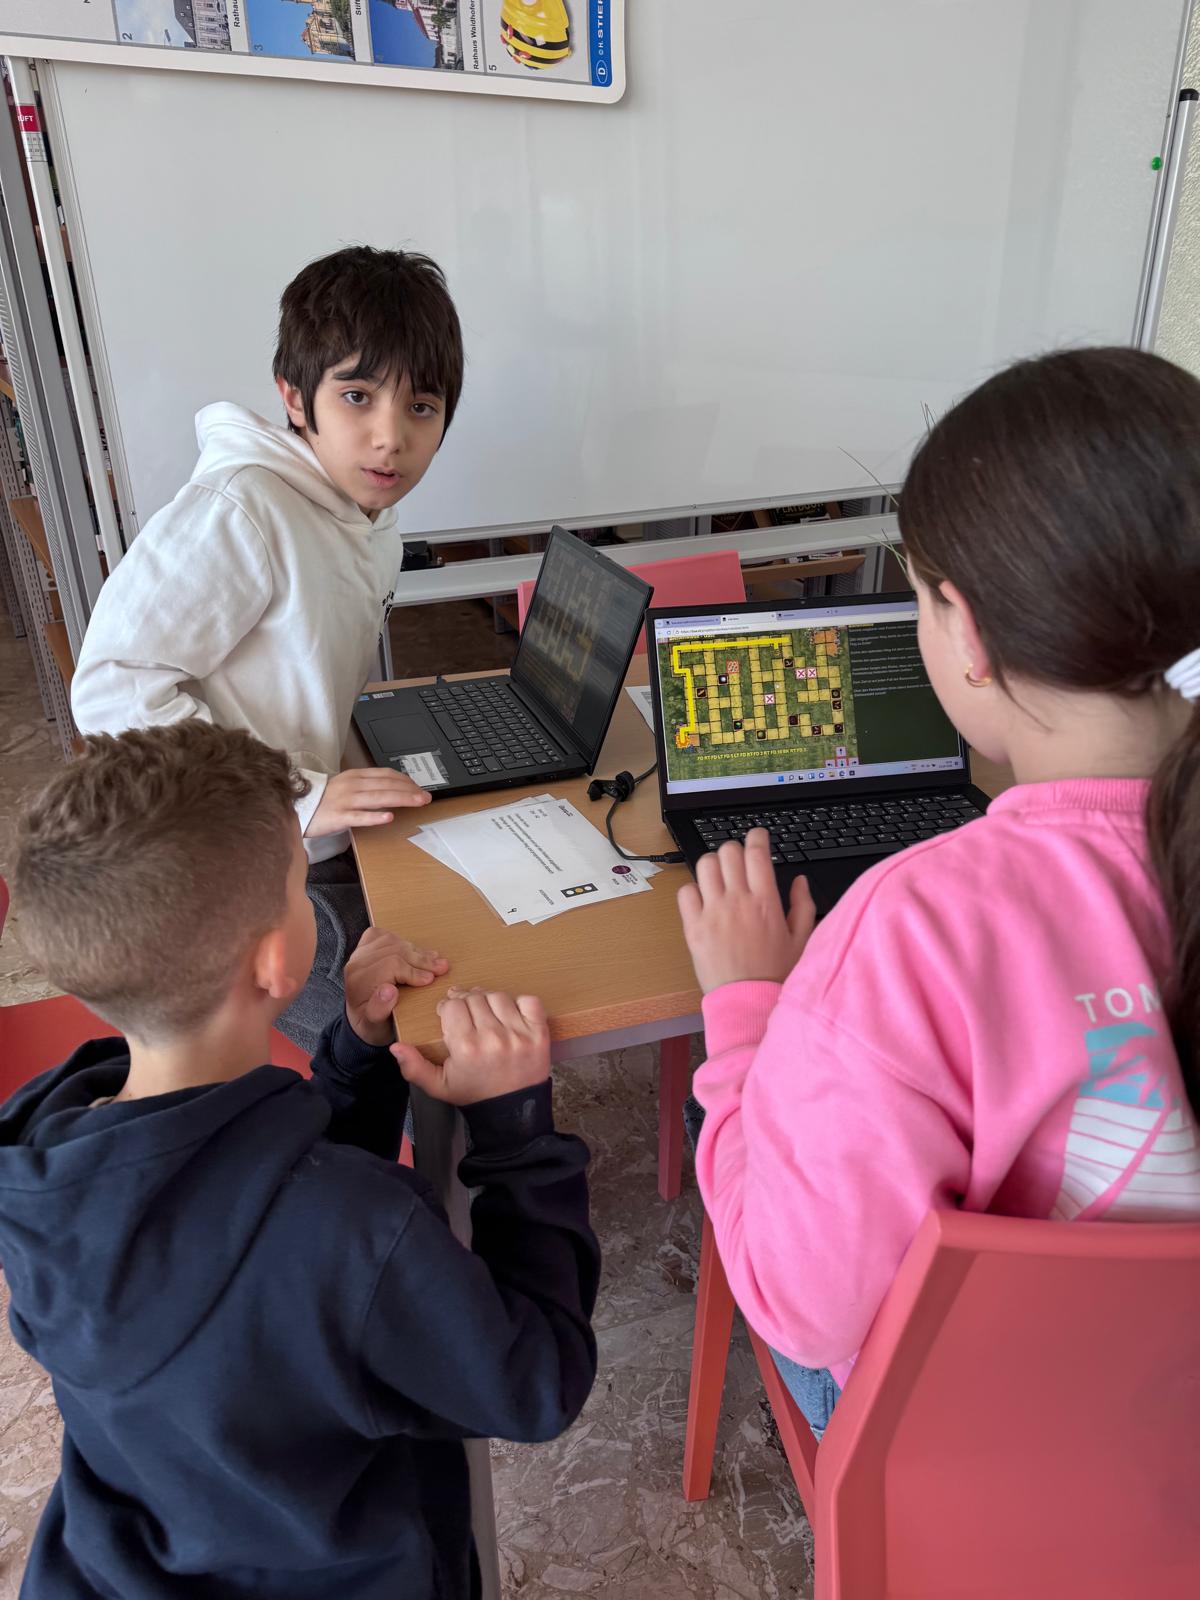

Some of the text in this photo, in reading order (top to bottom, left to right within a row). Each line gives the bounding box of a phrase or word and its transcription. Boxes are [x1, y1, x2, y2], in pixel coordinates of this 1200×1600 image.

[122, 32, 132, 40] 2
[472, 40, 480, 70] Rathaus
[598, 67, 606, 76] D
